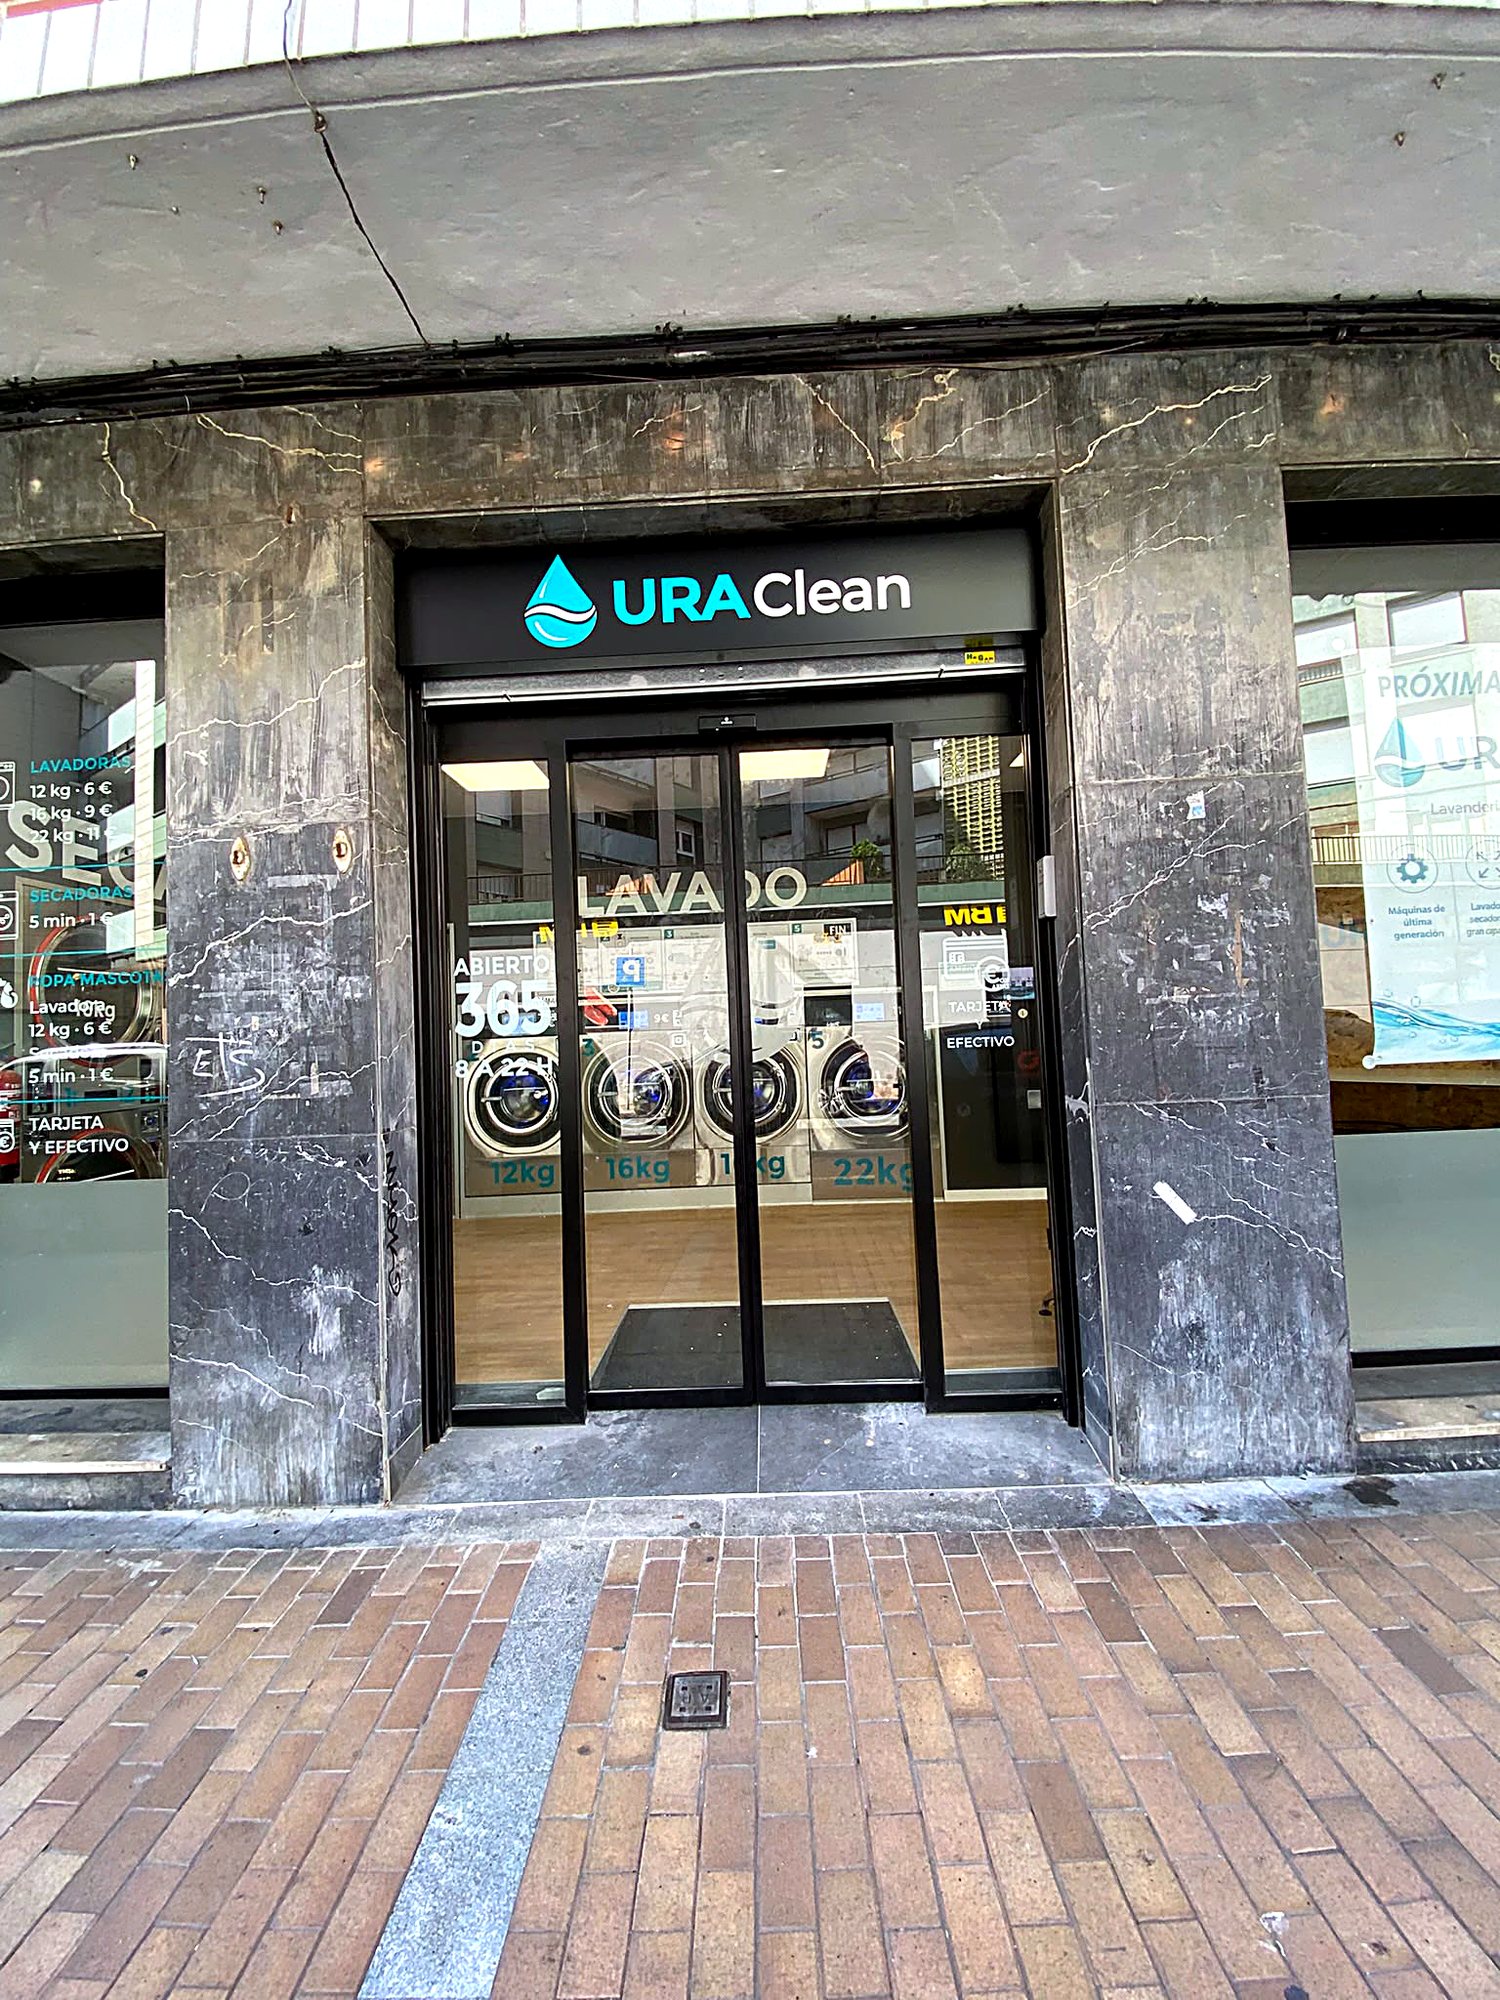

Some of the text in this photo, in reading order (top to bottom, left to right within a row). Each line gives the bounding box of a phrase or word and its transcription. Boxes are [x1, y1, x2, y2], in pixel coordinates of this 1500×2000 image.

[613, 567, 911, 626] URA Clean
[1377, 666, 1500, 698] PRÓXIMA
[30, 755, 132, 774] LAVADORAS
[30, 781, 112, 800] 12 kg 6 €
[51, 805, 72, 823] kg
[84, 804, 95, 818] 9
[30, 828, 49, 844] 22
[53, 827, 75, 845] kg
[86, 826, 100, 841] 11
[30, 886, 133, 903] SECADORAS
[1388, 904, 1446, 916] Máquinas de
[29, 914, 39, 929] 5
[43, 912, 77, 928] min
[89, 912, 95, 926] 1
[1393, 929, 1445, 941] generación
[454, 954, 550, 977] ABIERTO
[80, 970, 167, 987] MASCOTA
[29, 999, 106, 1015] Lavadora
[454, 979, 552, 1038] 365
[948, 1000, 1012, 1013] TARJETA
[28, 1021, 112, 1039] 12 kg 6 €
[946, 1035, 1016, 1049] EFECTIVO
[29, 1067, 40, 1084] 5
[43, 1068, 76, 1084] min
[454, 1059, 469, 1079] 8
[478, 1059, 495, 1078] A
[500, 1056, 530, 1077] 22
[28, 1115, 105, 1132] TARJETA
[28, 1138, 129, 1155] Y EFECTIVO
[490, 1160, 555, 1188] 12kg
[605, 1155, 670, 1183] 16kg
[720, 1152, 785, 1179] 1kg
[834, 1155, 913, 1192] 22kg
